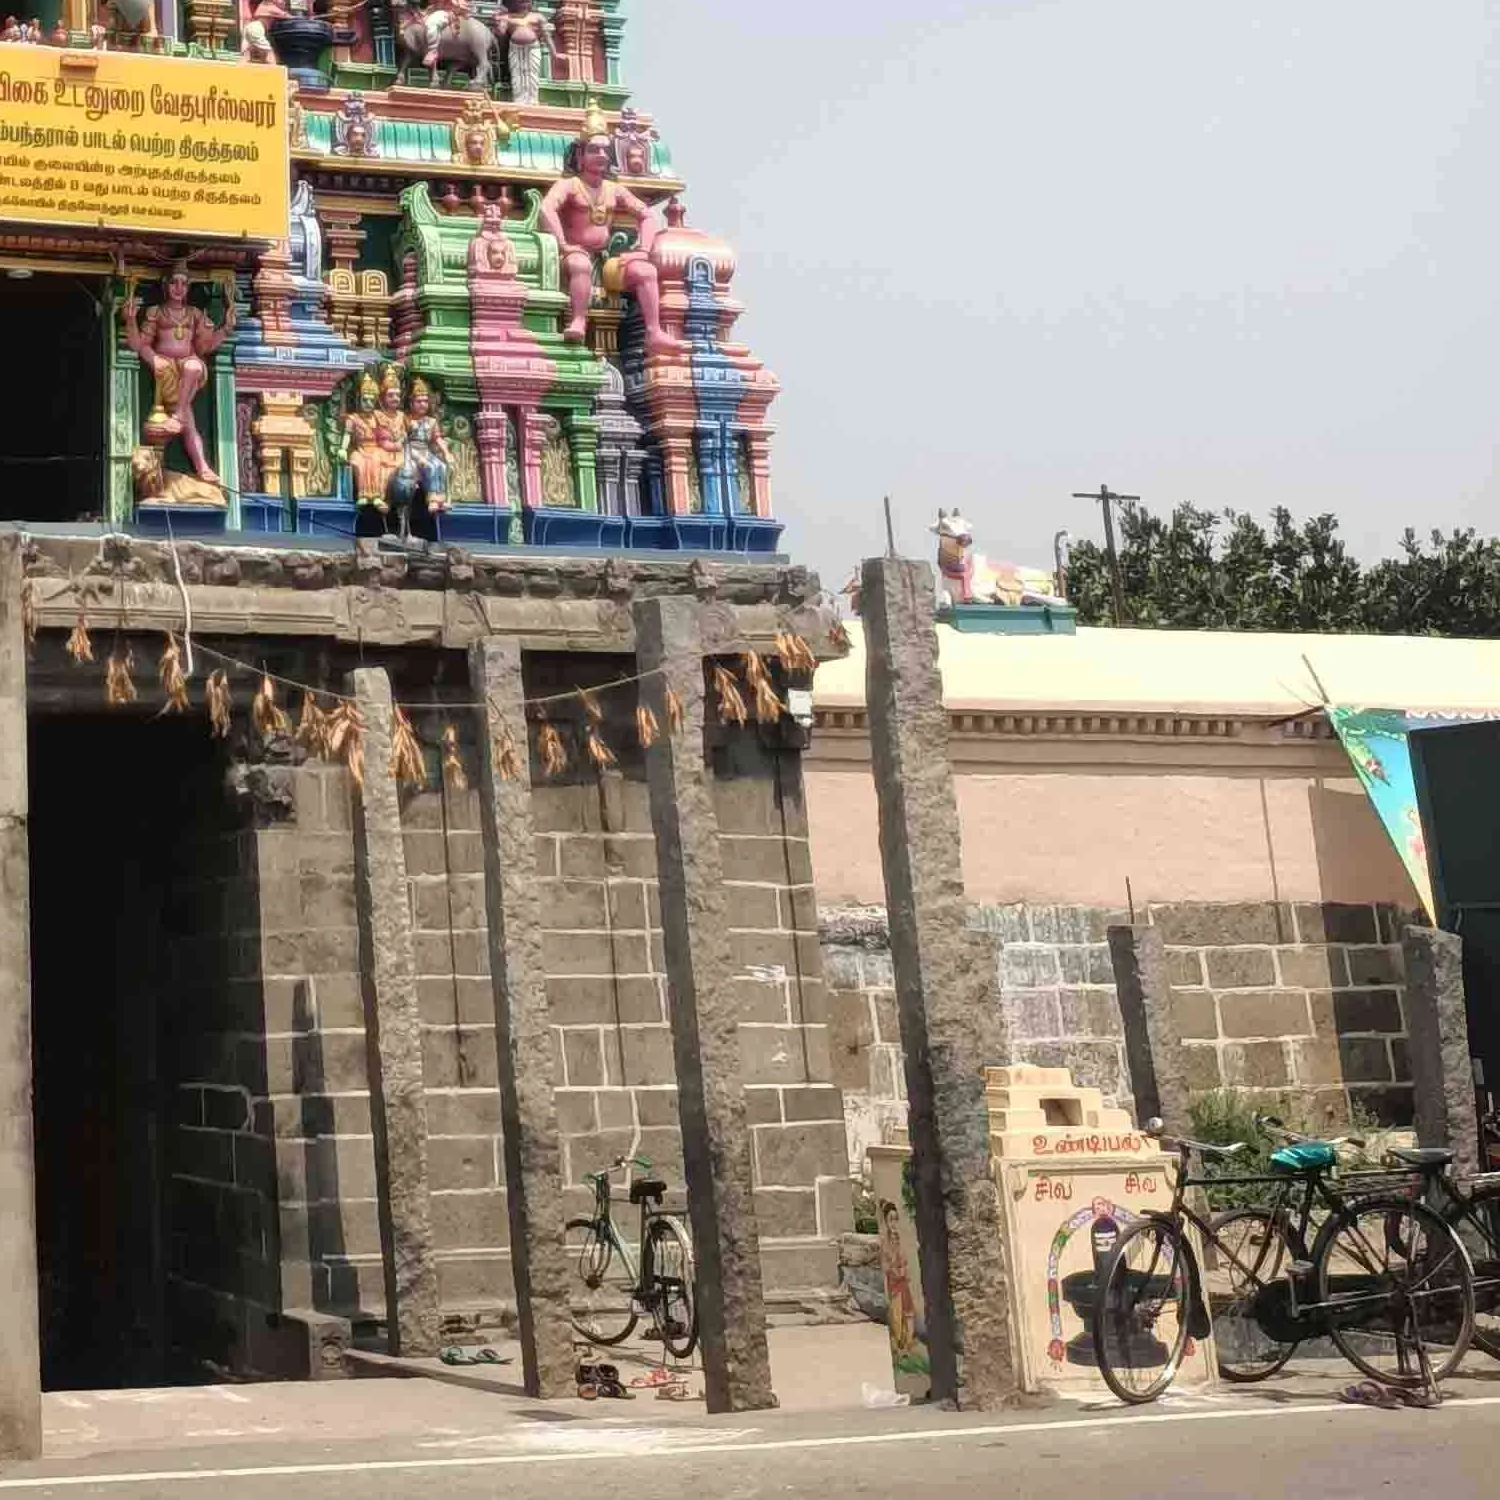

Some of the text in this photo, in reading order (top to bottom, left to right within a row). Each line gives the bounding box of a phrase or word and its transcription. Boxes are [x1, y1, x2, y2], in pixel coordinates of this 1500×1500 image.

[53, 77, 145, 122] உடனுறை
[150, 84, 277, 129] வேதபுரீஸ்வரர்
[82, 129, 126, 150] பாடல்
[130, 133, 176, 158] பெற்ற
[179, 134, 259, 164] திருத்தலம்
[1035, 1171, 1157, 1201] சிவ சிவ
